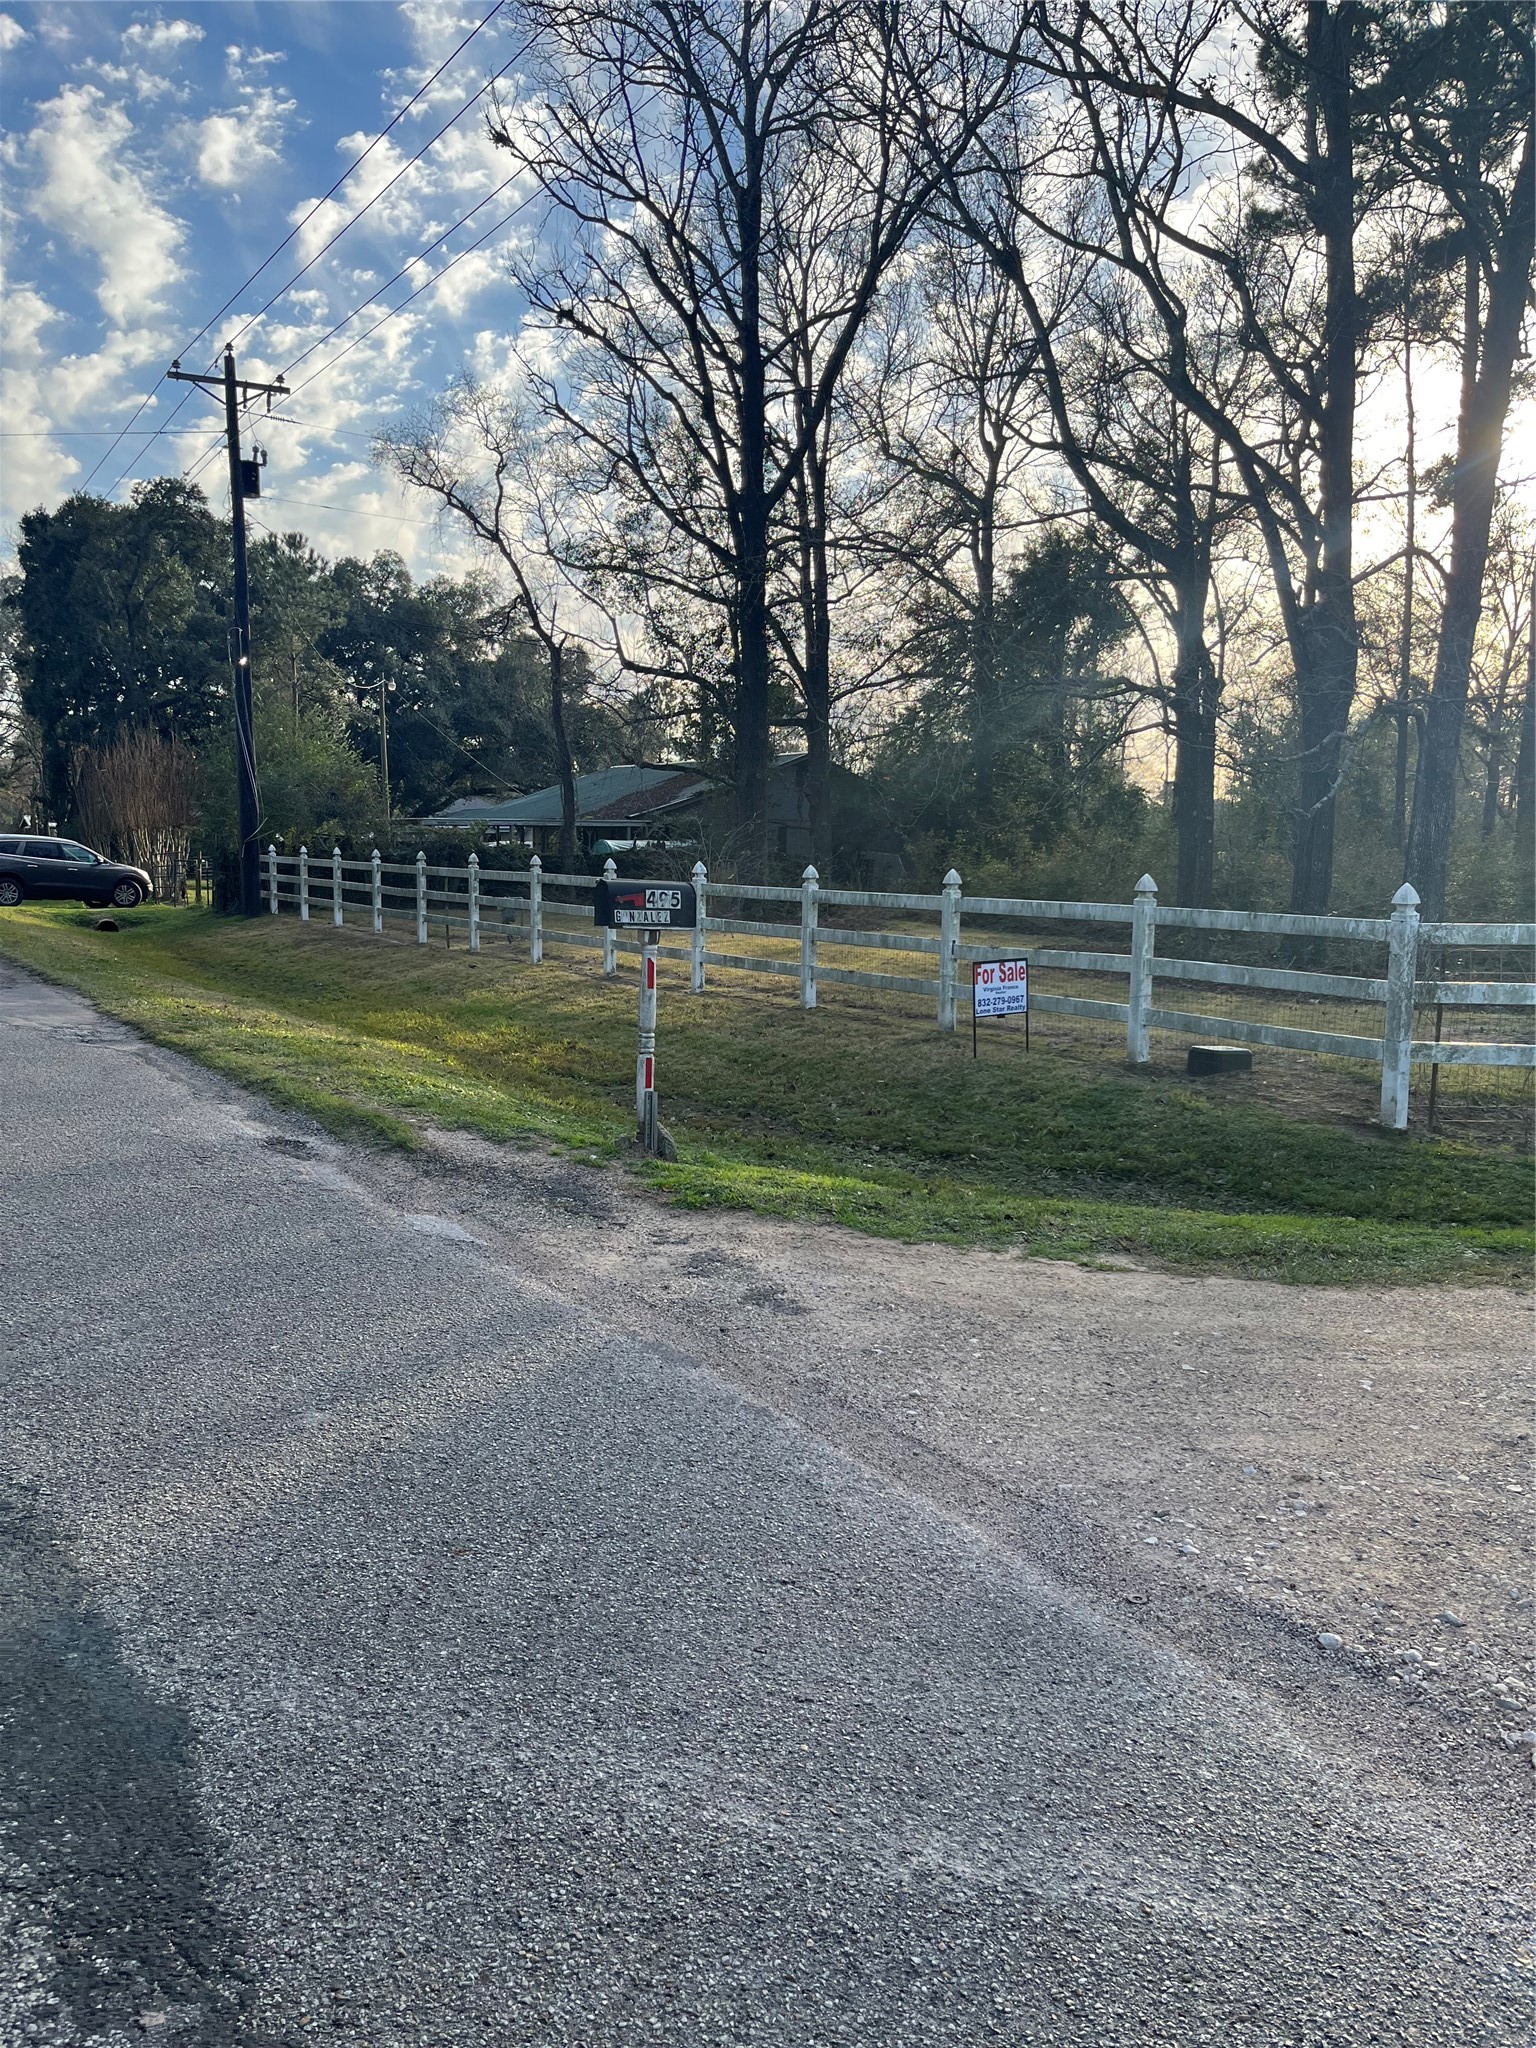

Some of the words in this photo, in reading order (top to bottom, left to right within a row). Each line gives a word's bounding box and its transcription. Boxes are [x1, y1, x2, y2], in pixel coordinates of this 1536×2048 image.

[616, 910, 669, 922] GNZALEZ
[975, 963, 995, 985] For
[999, 961, 1025, 983] Sale
[977, 995, 1024, 1007] 832-279-0967
[1007, 1004, 1025, 1012] Realty
